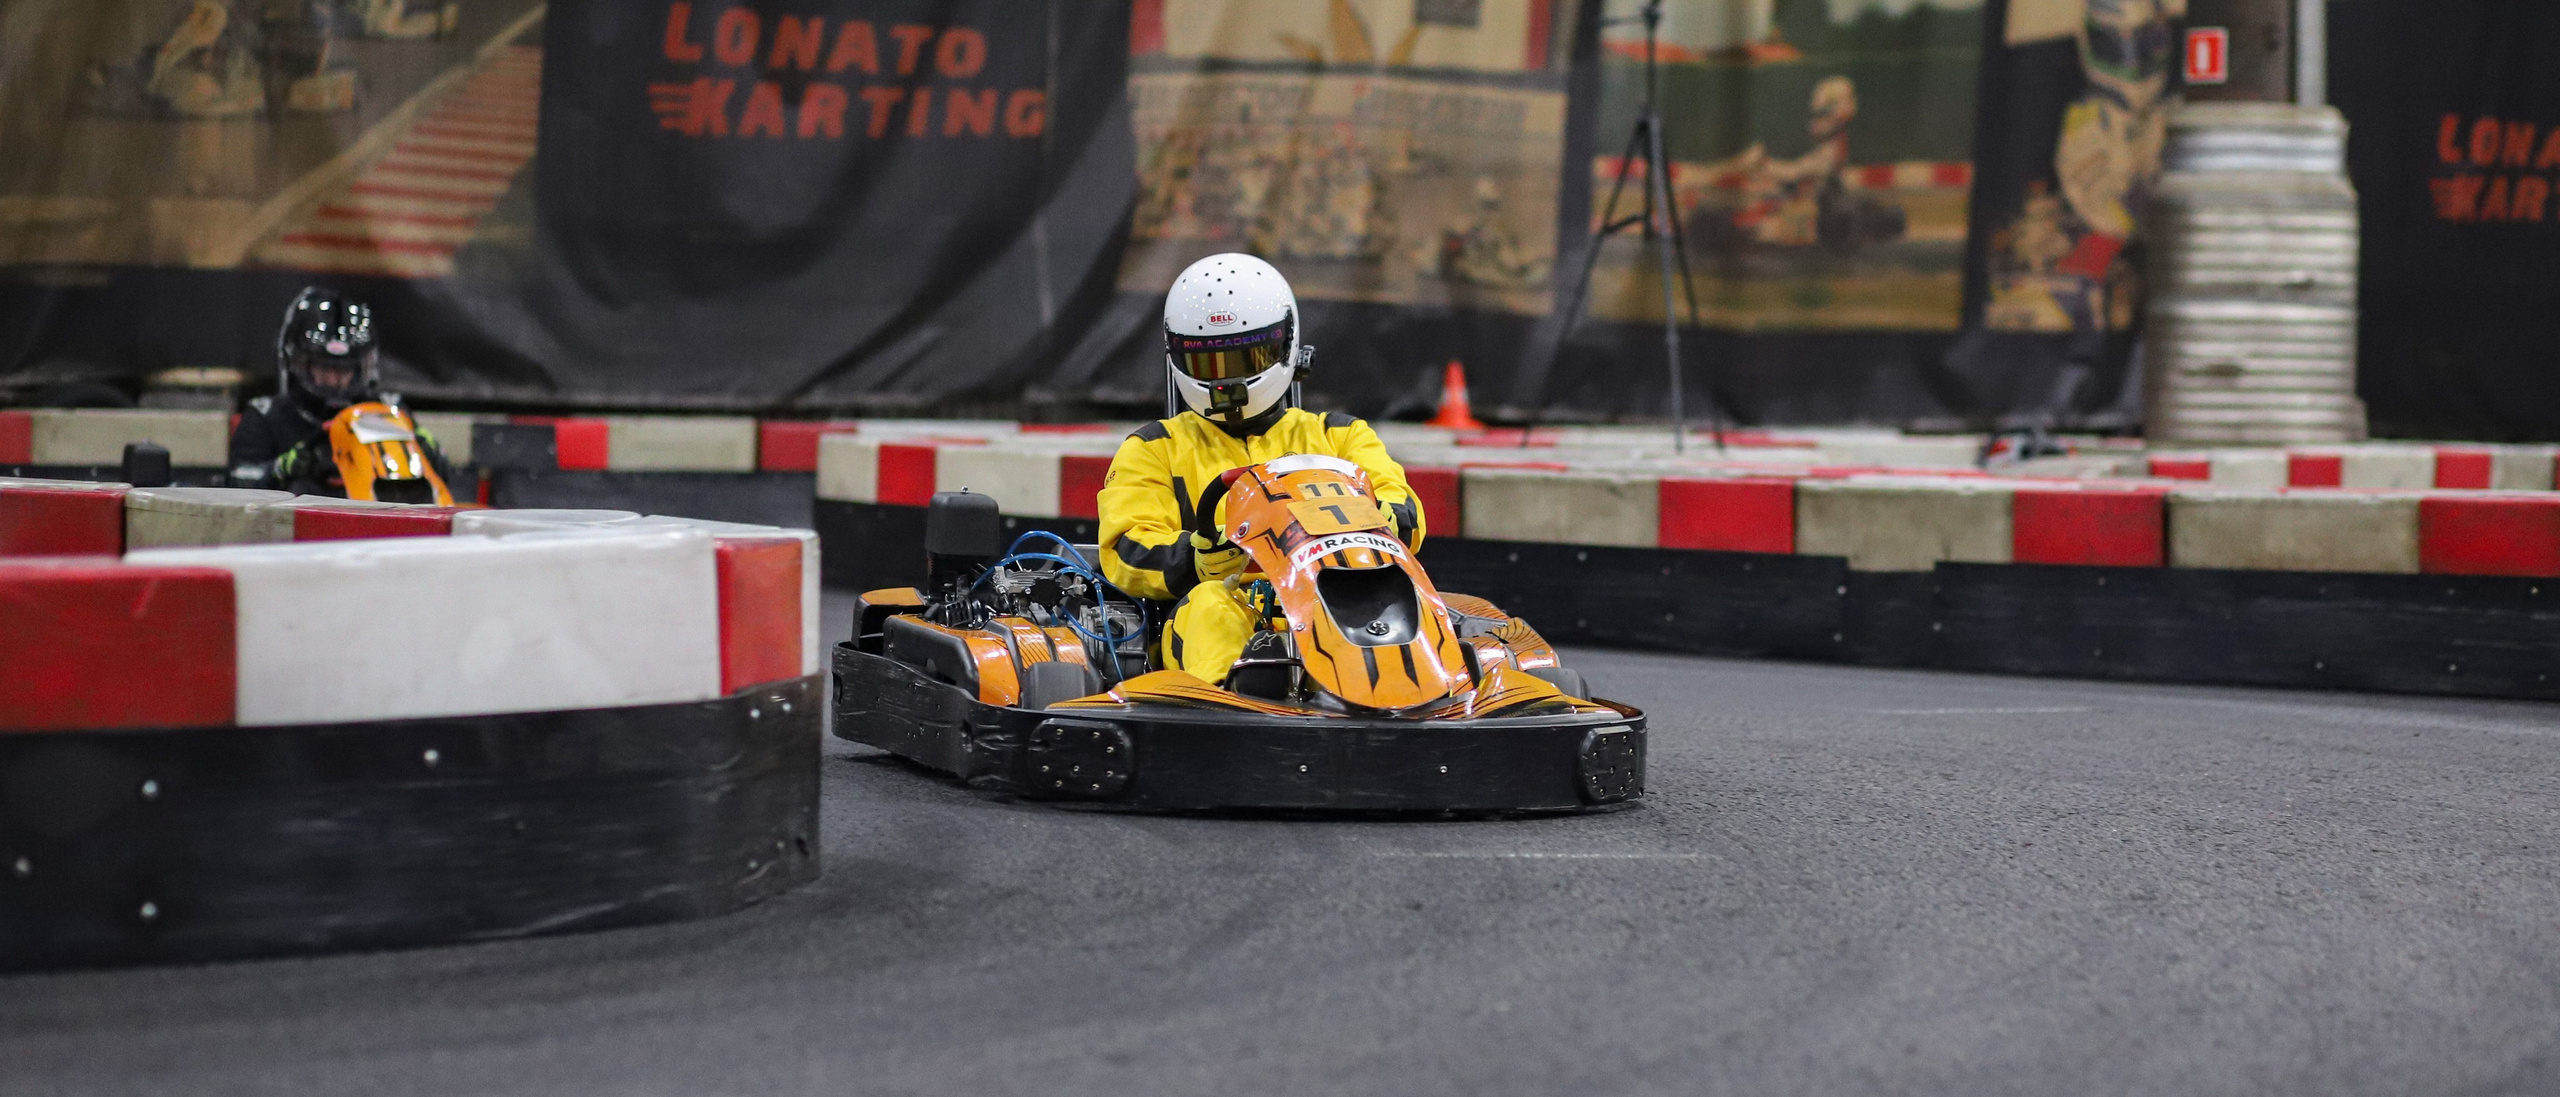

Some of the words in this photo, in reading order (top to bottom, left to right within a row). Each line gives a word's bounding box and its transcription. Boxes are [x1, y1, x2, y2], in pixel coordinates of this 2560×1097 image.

[664, 2, 988, 78] LONATO
[648, 79, 1047, 138] KARTING
[2438, 114, 2560, 168] LONA
[2428, 173, 2560, 222] KAR
[1183, 340, 1204, 349] RVA
[1207, 333, 1266, 347] ACADEMY
[1305, 483, 1344, 496] 11
[1319, 505, 1350, 524] 1
